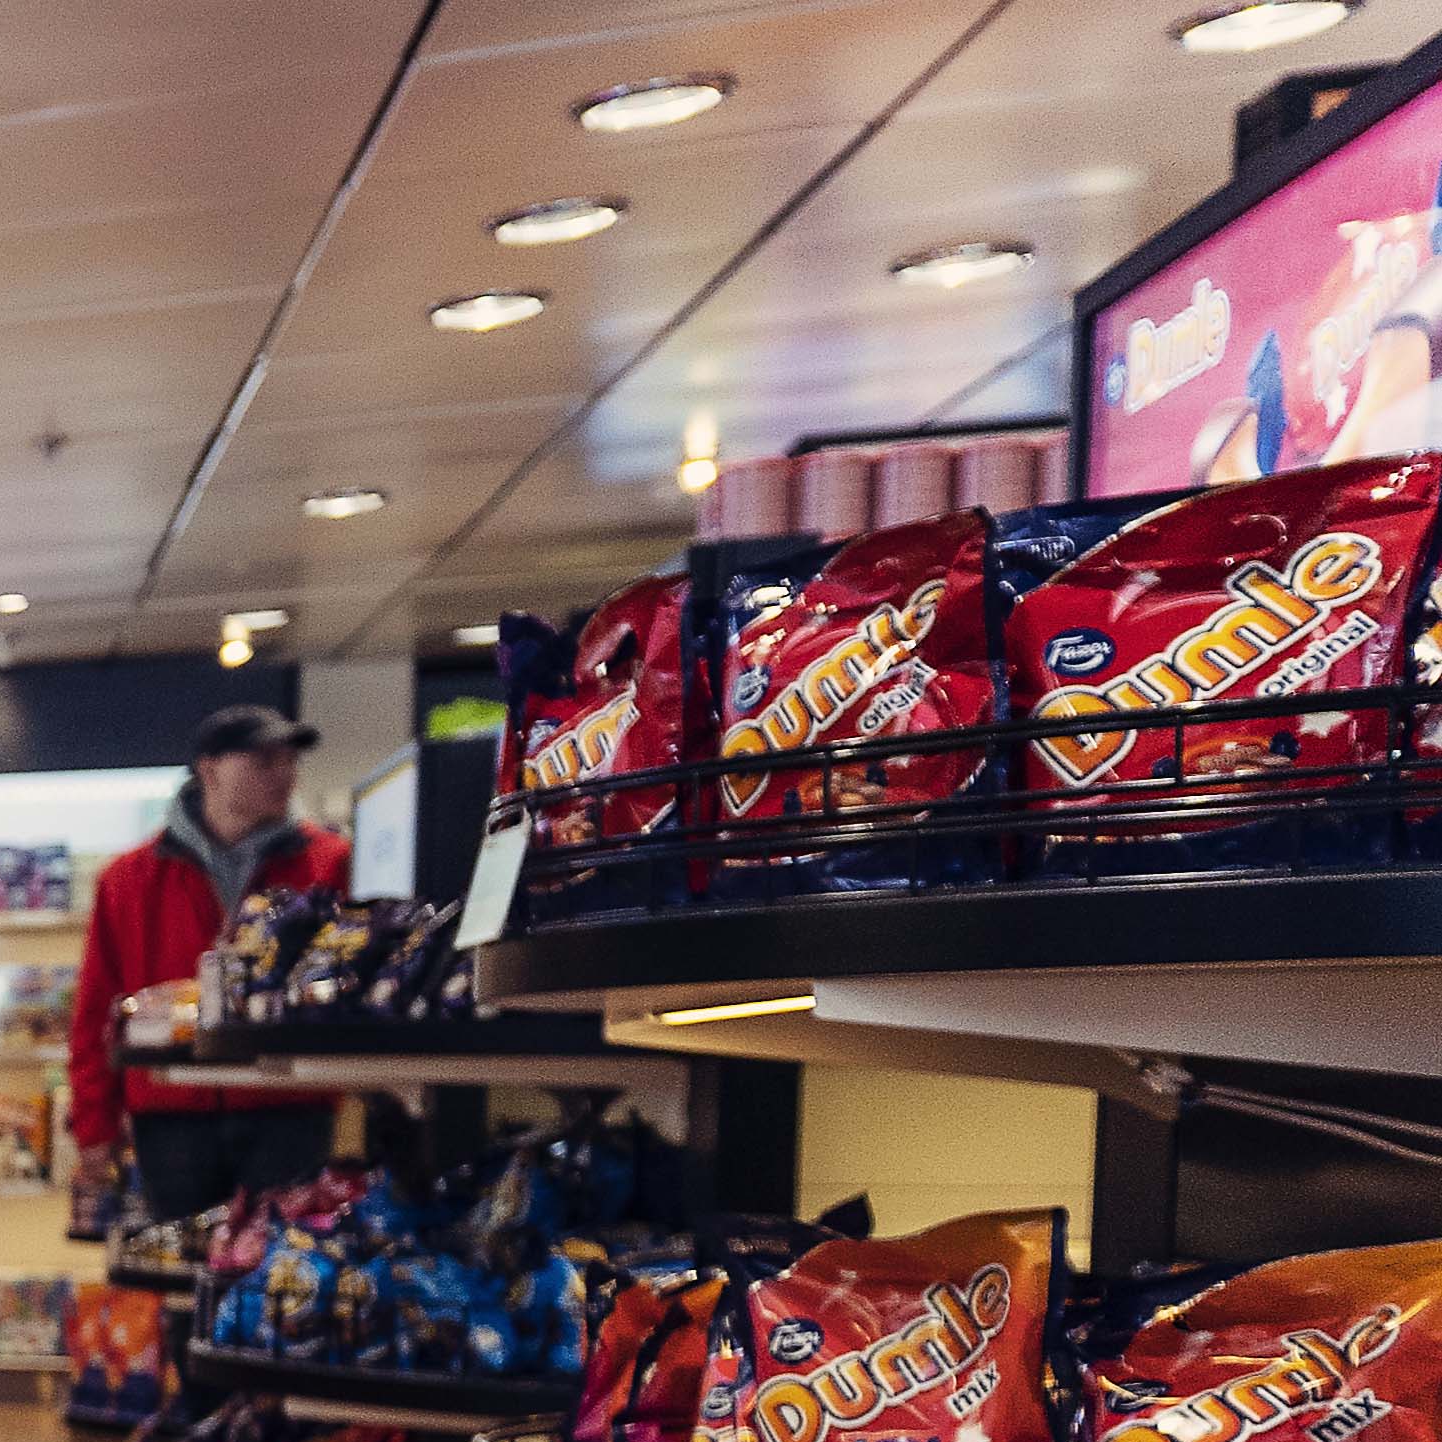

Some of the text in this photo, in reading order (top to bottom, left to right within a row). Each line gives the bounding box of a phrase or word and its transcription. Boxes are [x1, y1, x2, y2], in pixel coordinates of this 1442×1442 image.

[1030, 534, 1381, 790] Dumle
[1258, 612, 1379, 698] original
[720, 581, 950, 819] Dumle
[856, 664, 937, 737] original
[951, 1364, 1000, 1414] mix
